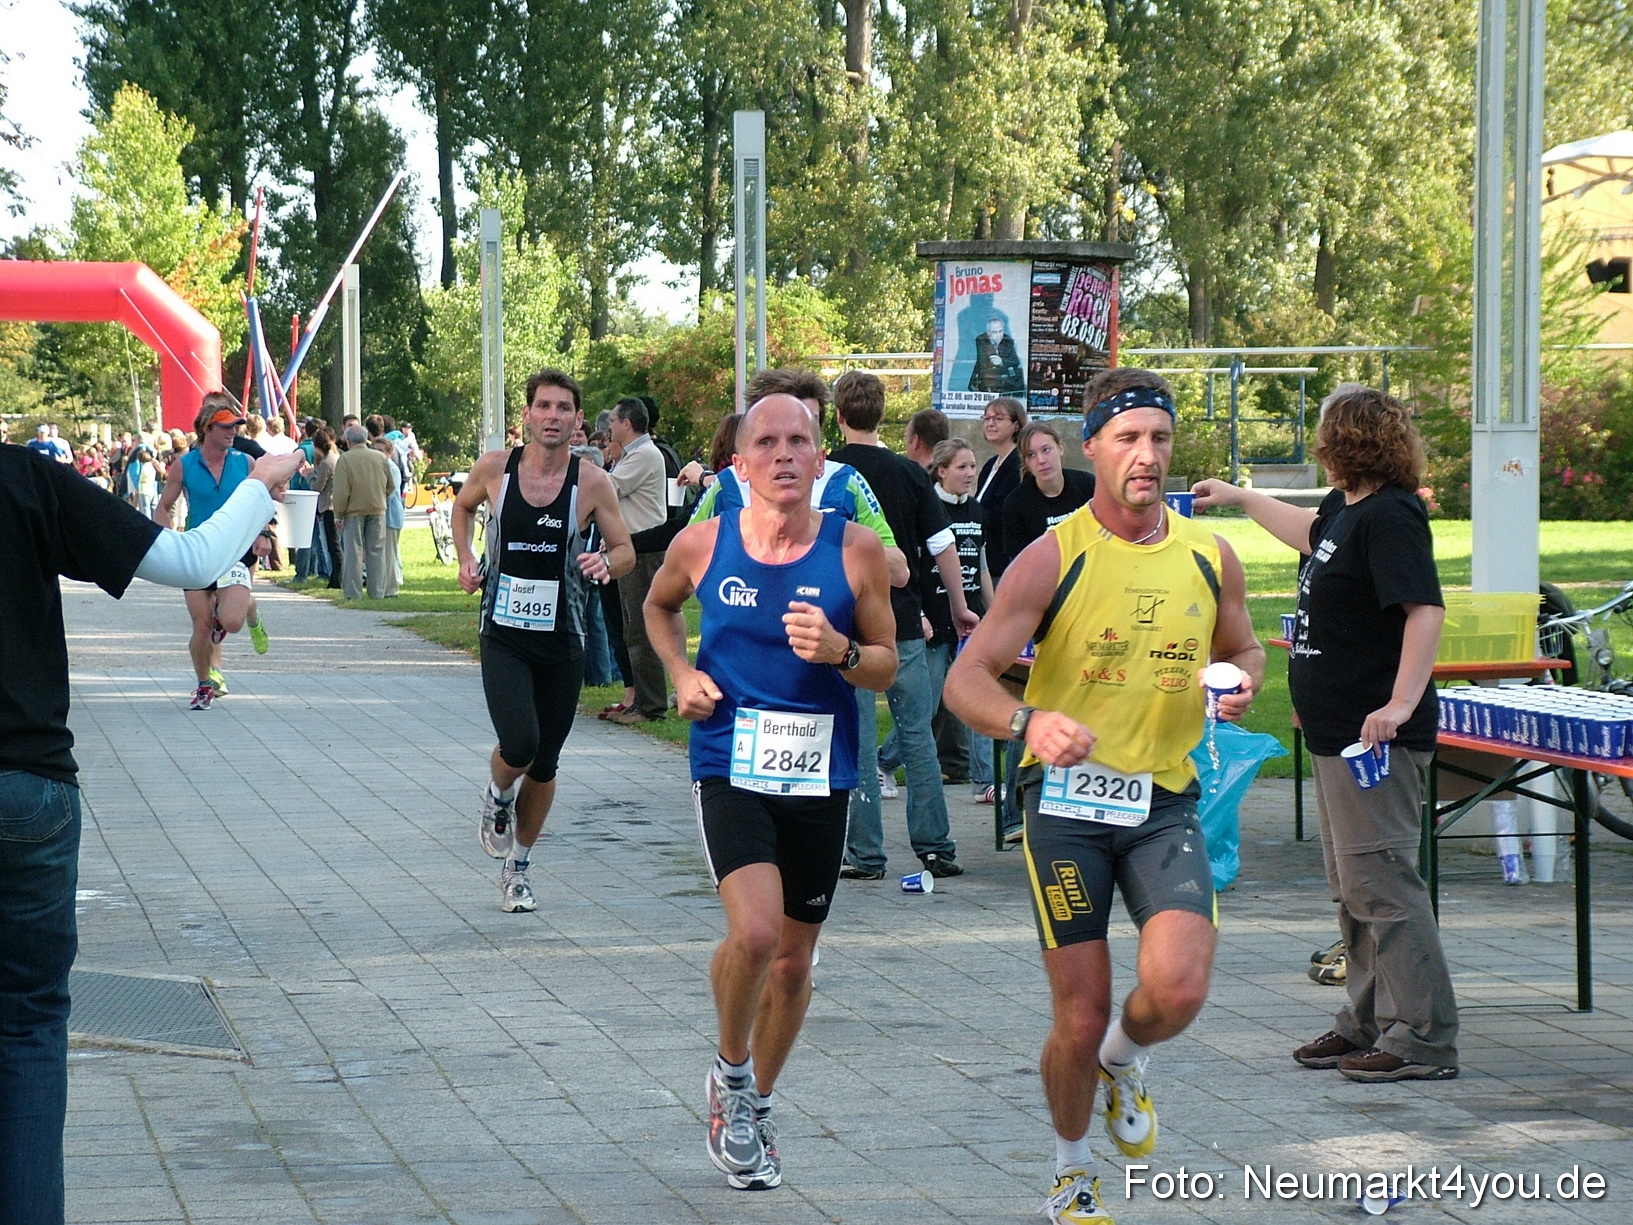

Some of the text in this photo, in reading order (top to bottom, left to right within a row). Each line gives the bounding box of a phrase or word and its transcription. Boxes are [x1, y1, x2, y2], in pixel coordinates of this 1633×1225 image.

[956, 266, 983, 277] Bruno
[949, 273, 1003, 304] Jonas
[1066, 287, 1111, 332] ROCK
[1061, 314, 1107, 352] 08.09.07
[512, 583, 535, 594] Josef
[512, 601, 552, 617] 3495
[1080, 667, 1126, 682] M & S
[1154, 666, 1192, 679] PIZZERIA
[763, 719, 817, 737] Berthold
[737, 740, 822, 773] A 2842
[791, 783, 826, 791] PFLEIDERER
[1074, 773, 1142, 802] 2320
[1042, 802, 1146, 821] BOCK PFLEIDERER
[1059, 867, 1088, 907] Run!
[1052, 889, 1068, 917] Team
